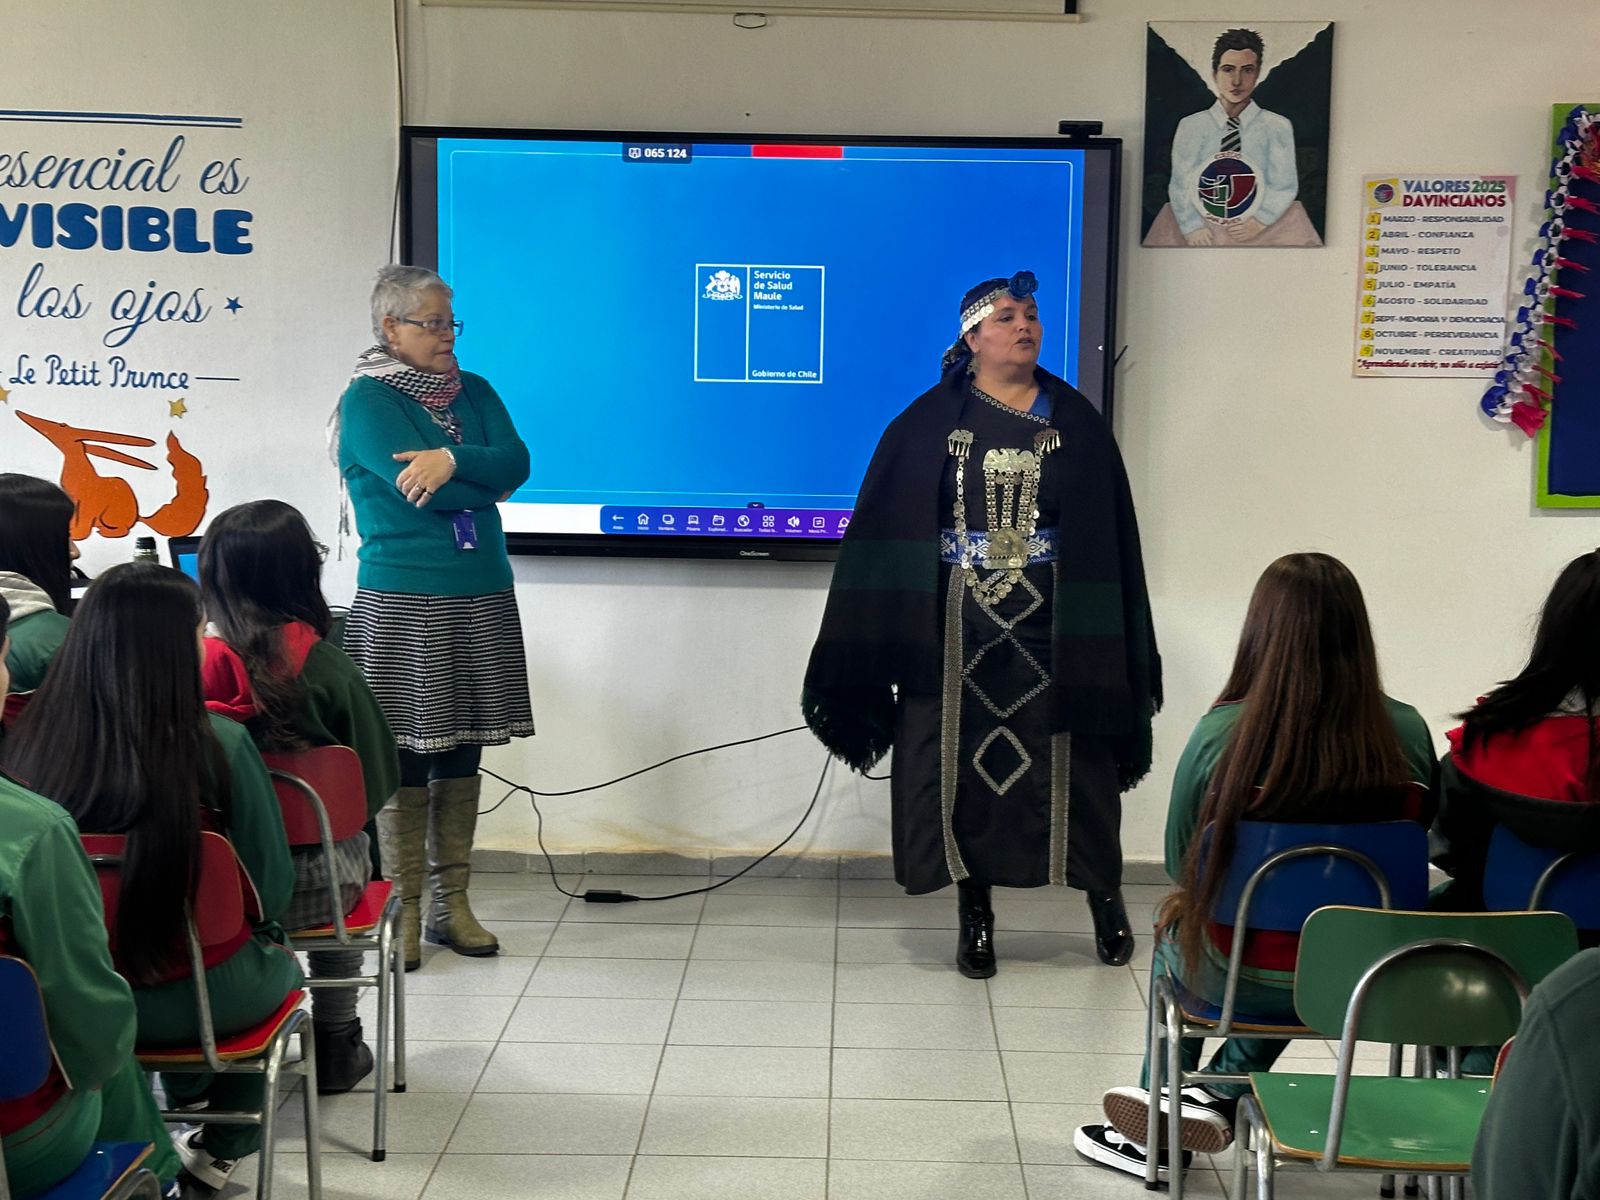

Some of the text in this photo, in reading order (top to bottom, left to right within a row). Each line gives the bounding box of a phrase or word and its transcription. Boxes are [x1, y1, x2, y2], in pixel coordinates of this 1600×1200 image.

[644, 147, 687, 159] 065 124
[0, 135, 249, 194] esencial es
[1403, 181, 1506, 193] VALORES 2025
[1403, 195, 1506, 207] DAVINCIANOS
[753, 270, 791, 279] Servicio
[753, 281, 793, 290] de Salud
[1377, 281, 1405, 289] JULIO
[1413, 280, 1456, 289] EMPATÍA
[753, 291, 783, 301] Maule
[17, 262, 212, 348] los ojos
[1424, 331, 1499, 339] PERSEVERANCIA
[9, 354, 189, 390] Le Petit Prince
[752, 370, 817, 379] Gobierno de Chile
